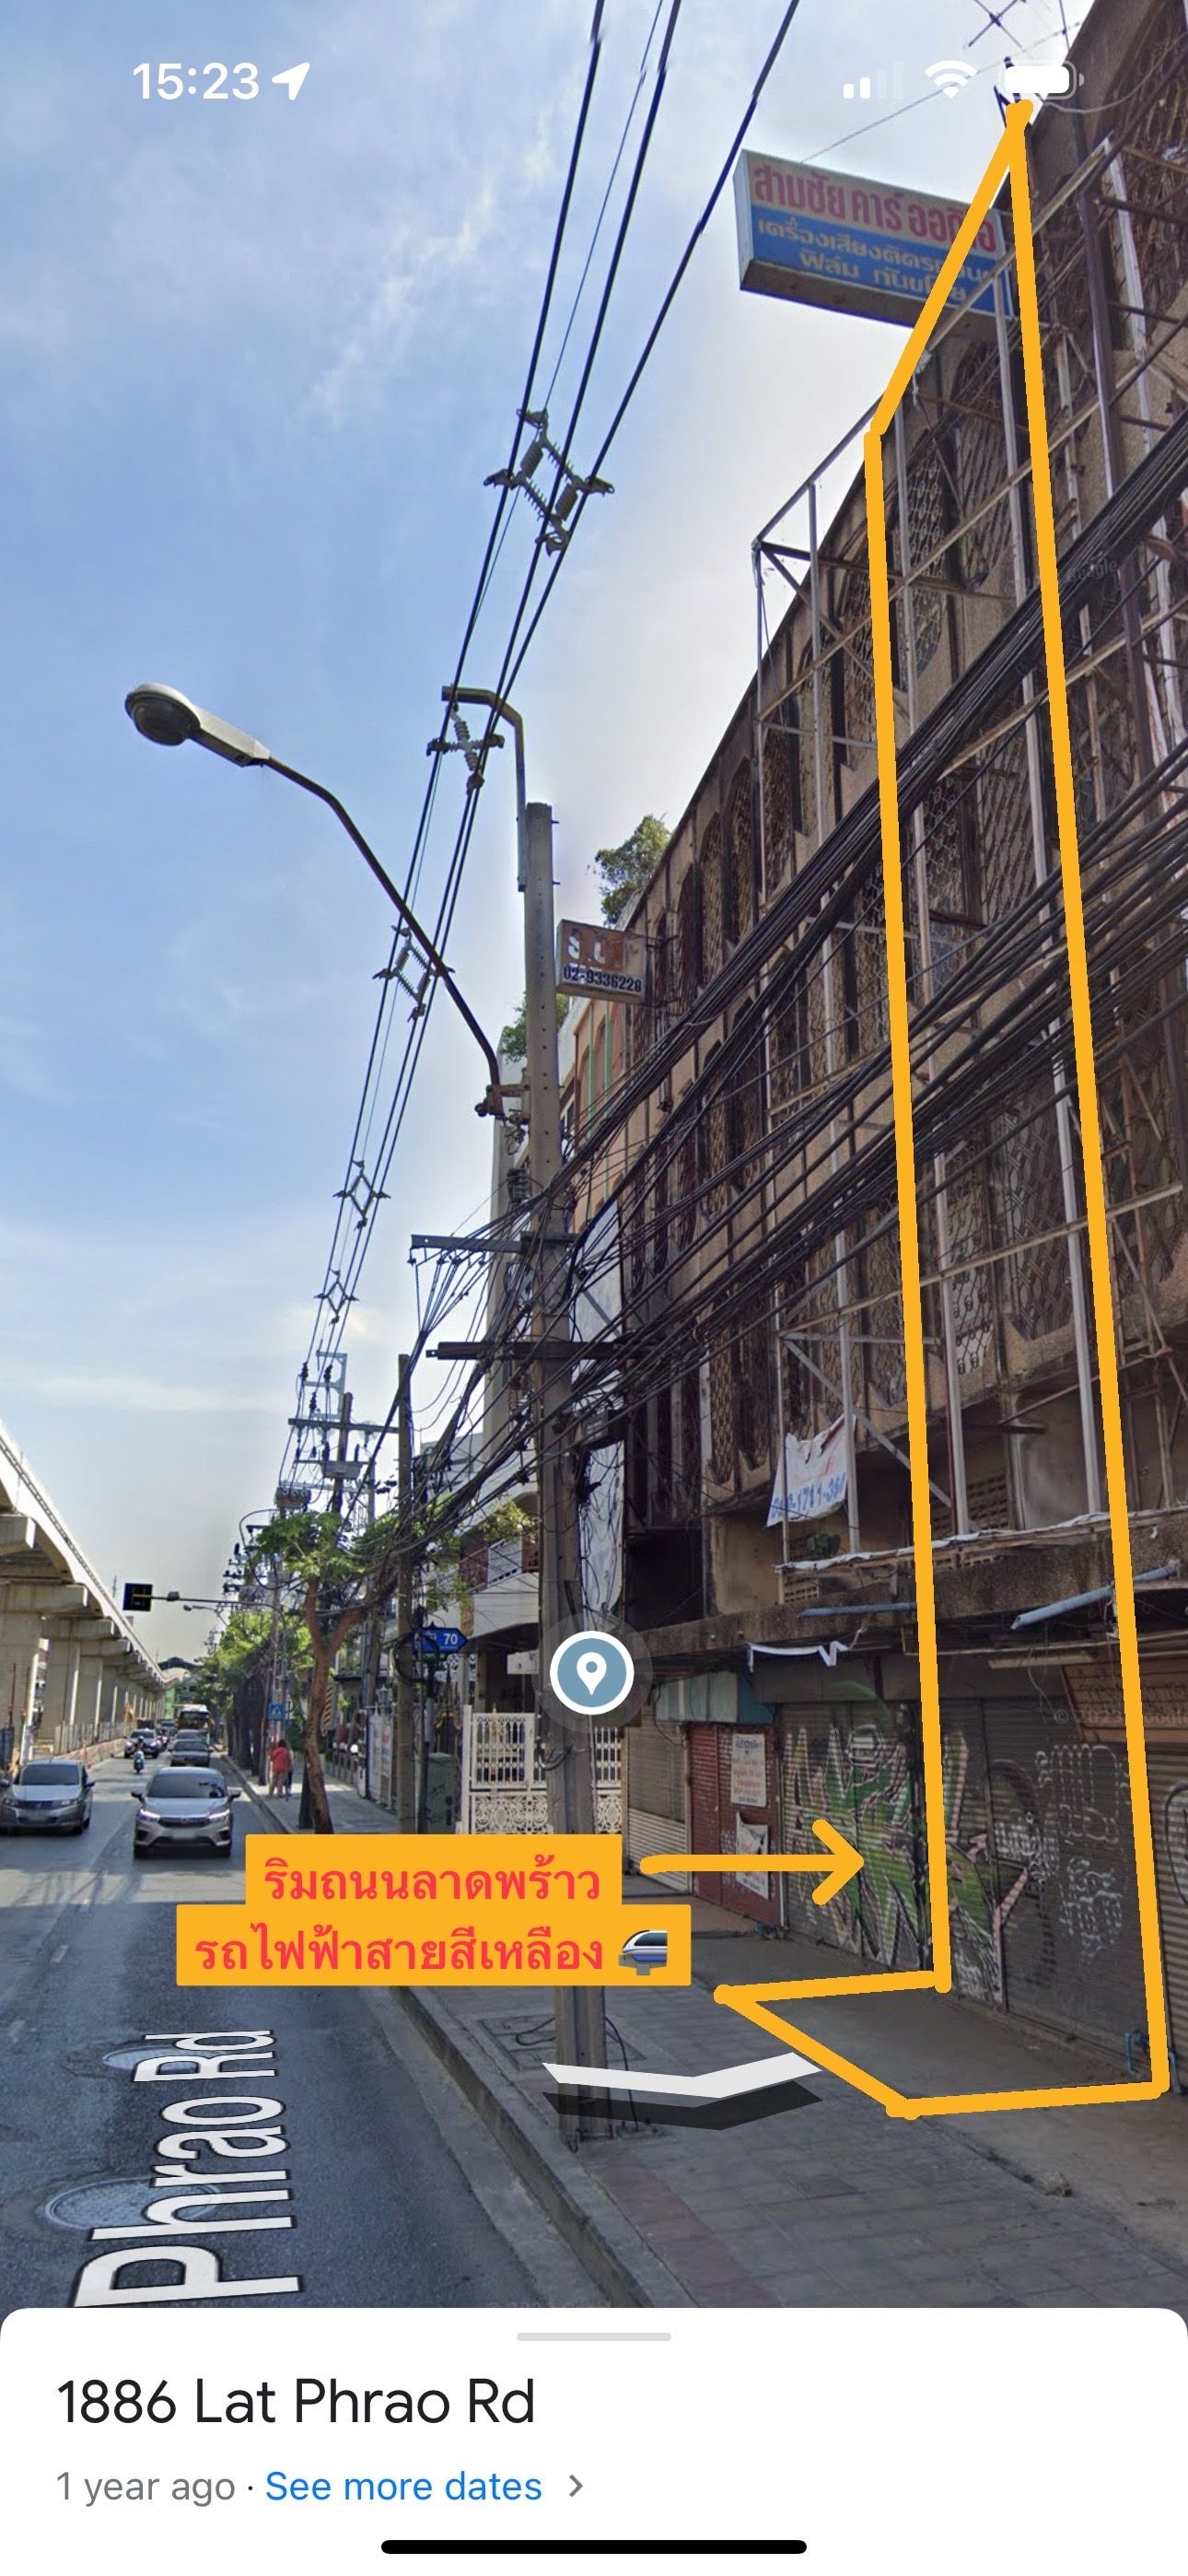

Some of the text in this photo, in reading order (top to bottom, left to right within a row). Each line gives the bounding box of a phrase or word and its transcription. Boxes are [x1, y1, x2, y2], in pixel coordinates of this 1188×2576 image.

[753, 166, 845, 220] สามชัย
[851, 190, 903, 232] คาร์
[798, 248, 859, 278] ฟิล์ม
[443, 1633, 458, 1645] 70
